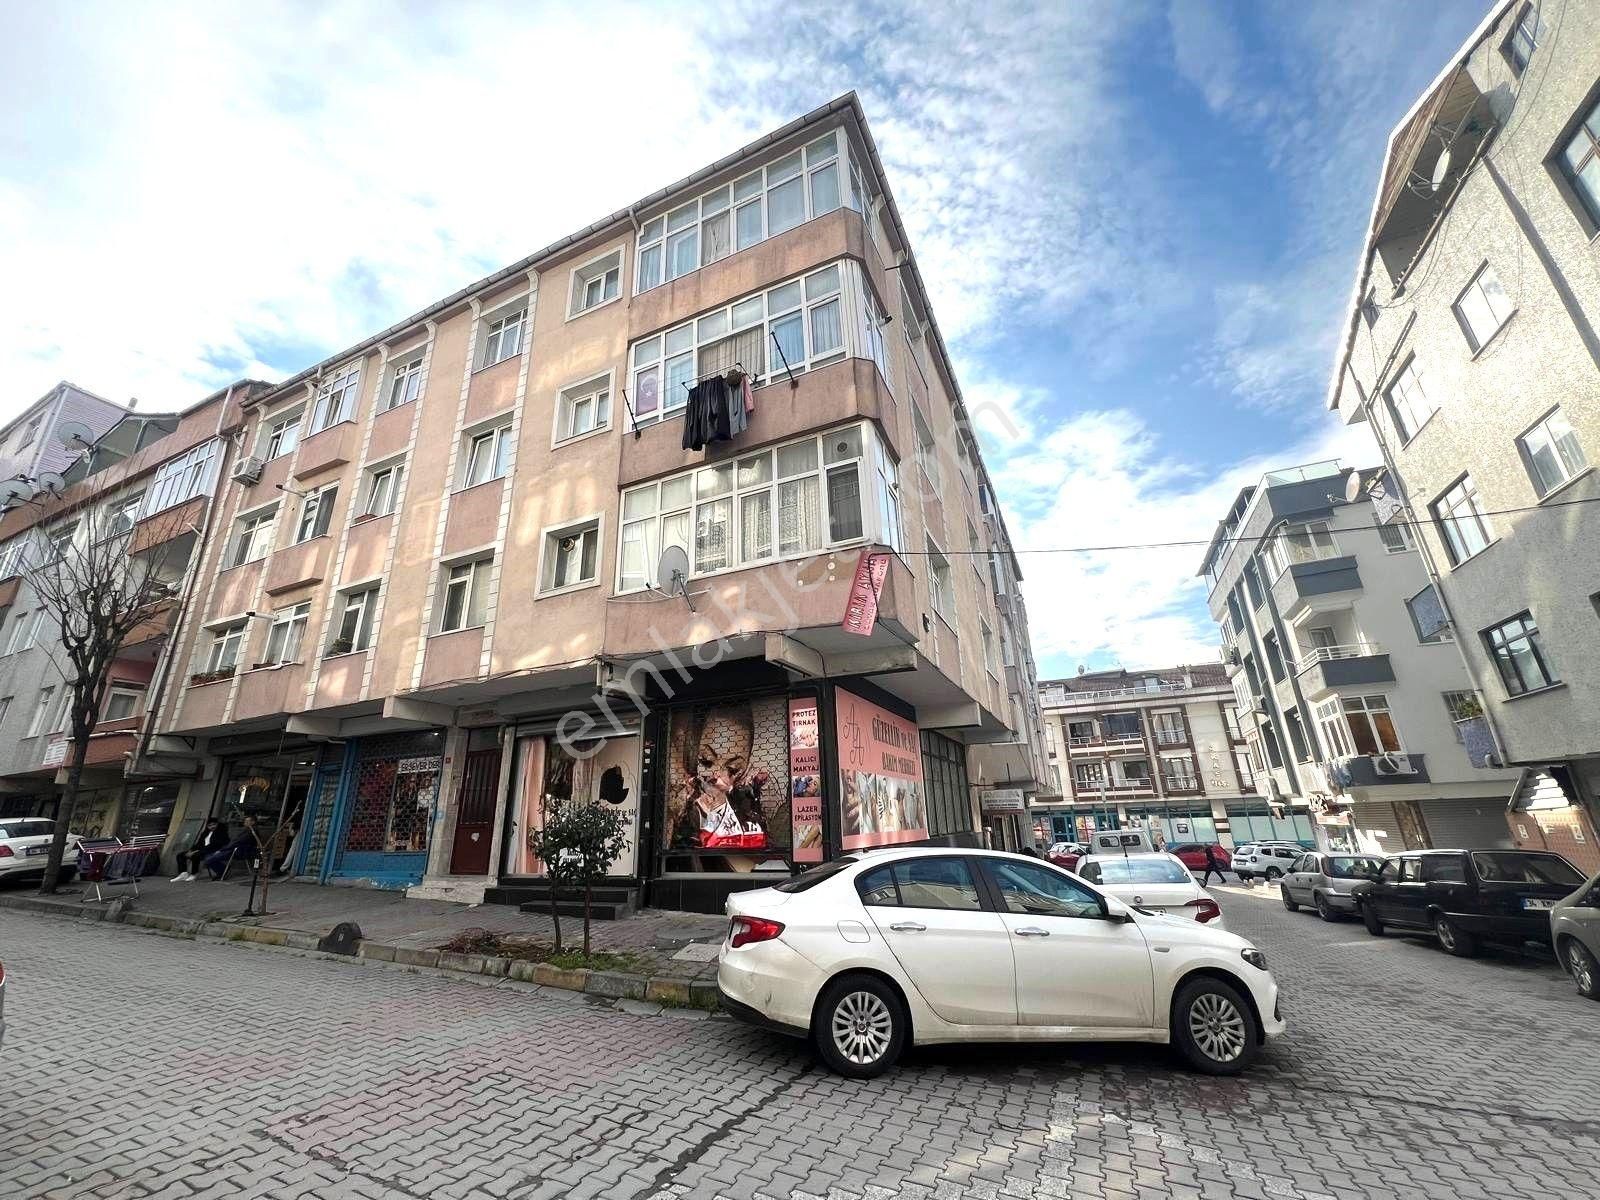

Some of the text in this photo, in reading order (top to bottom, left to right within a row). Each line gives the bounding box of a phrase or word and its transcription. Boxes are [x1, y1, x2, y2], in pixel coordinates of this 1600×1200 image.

[847, 590, 869, 630] KIRIK
[791, 710, 816, 718] PROTEZ
[792, 719, 816, 727] TIRNAK
[872, 713, 900, 747] GÜZELLİK
[900, 729, 908, 749] ve
[795, 755, 817, 764] KALICI
[793, 765, 819, 773] MAKYAJ
[797, 805, 818, 813] LAZER
[794, 813, 822, 822] EPİLASYON
